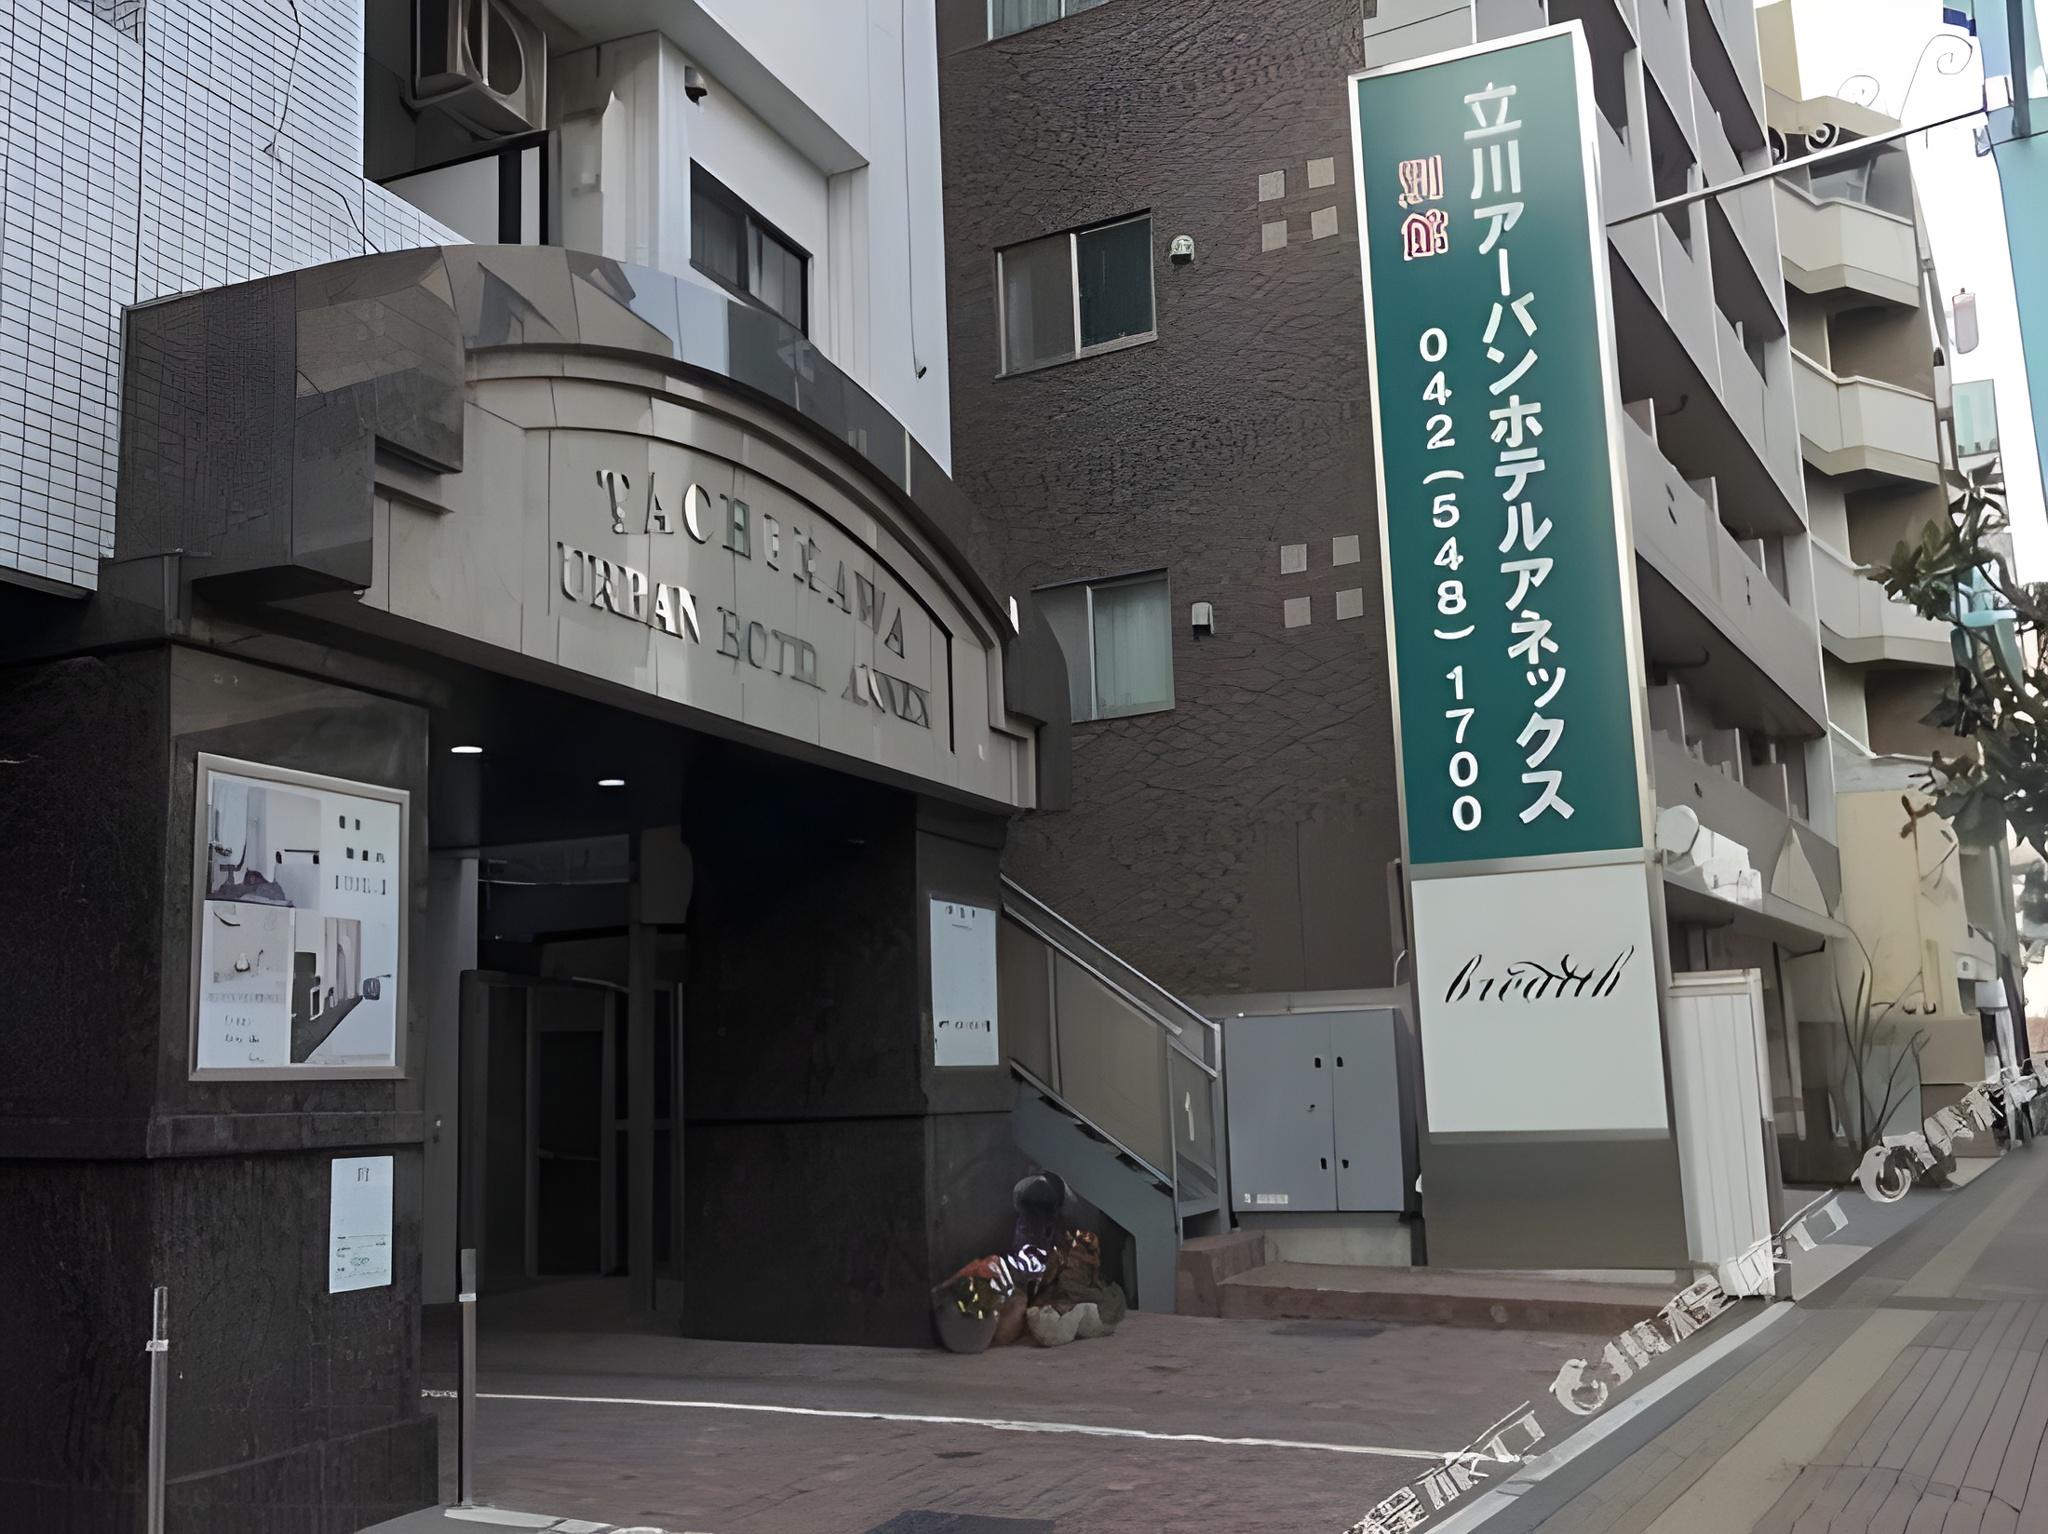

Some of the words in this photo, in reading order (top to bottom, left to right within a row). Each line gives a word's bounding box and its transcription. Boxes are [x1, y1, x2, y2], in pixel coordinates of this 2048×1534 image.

[1463, 82, 1575, 824] 立川アーバンホテルアネックス
